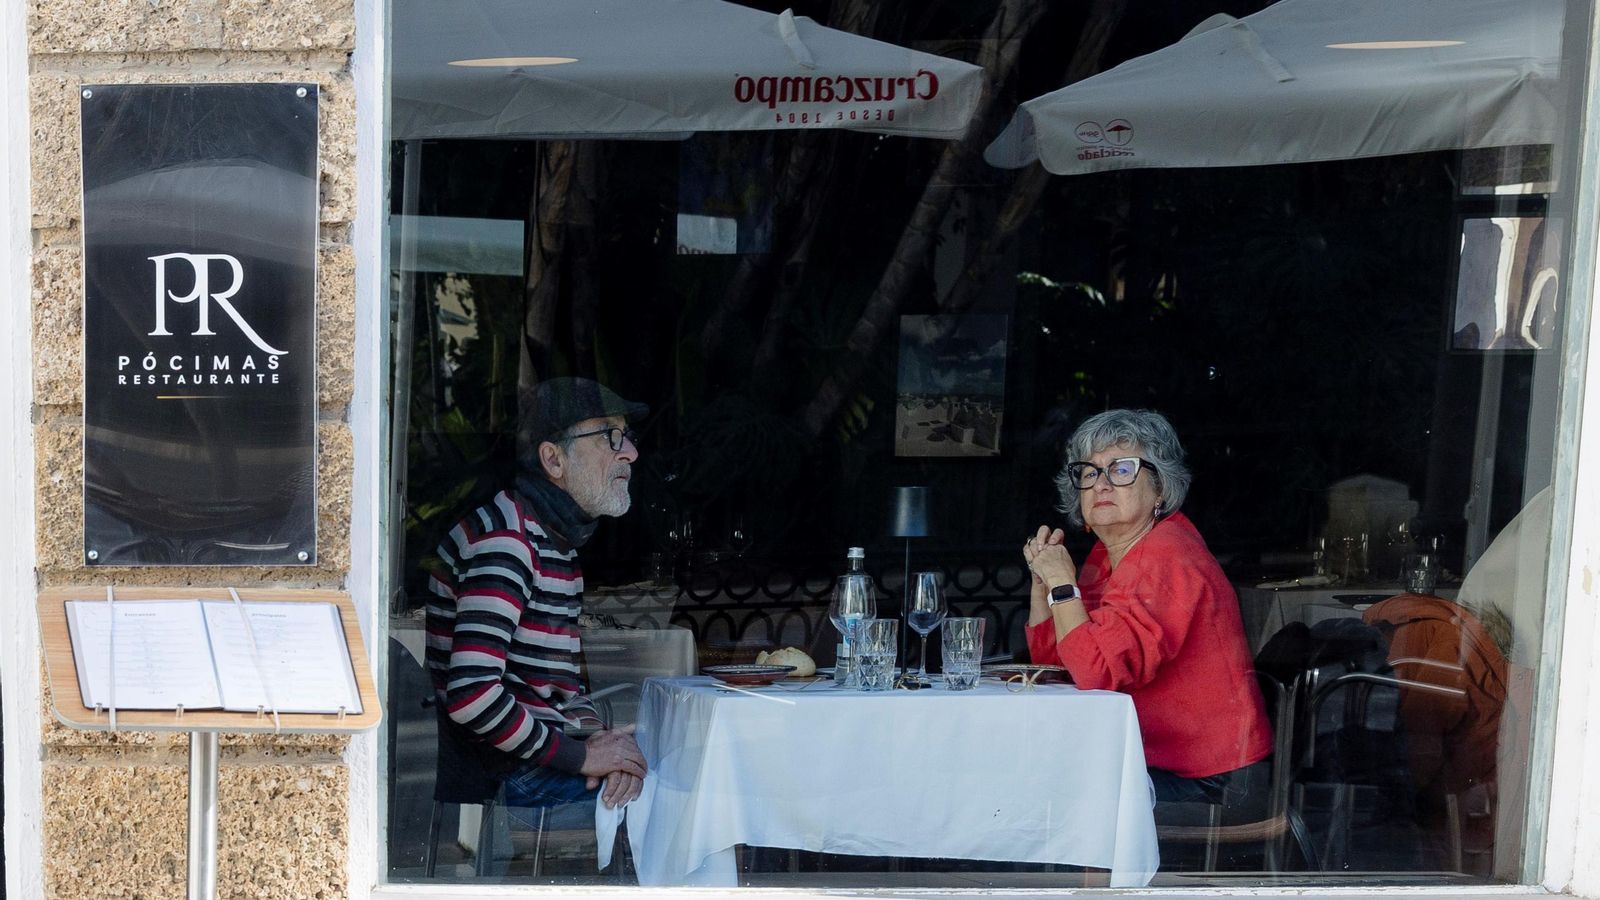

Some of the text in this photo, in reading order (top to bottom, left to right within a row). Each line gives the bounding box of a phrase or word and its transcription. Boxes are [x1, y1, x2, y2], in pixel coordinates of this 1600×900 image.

[147, 252, 289, 356] PR
[118, 352, 280, 371] PÓCIMAS
[118, 374, 280, 385] RESTAURANTE
